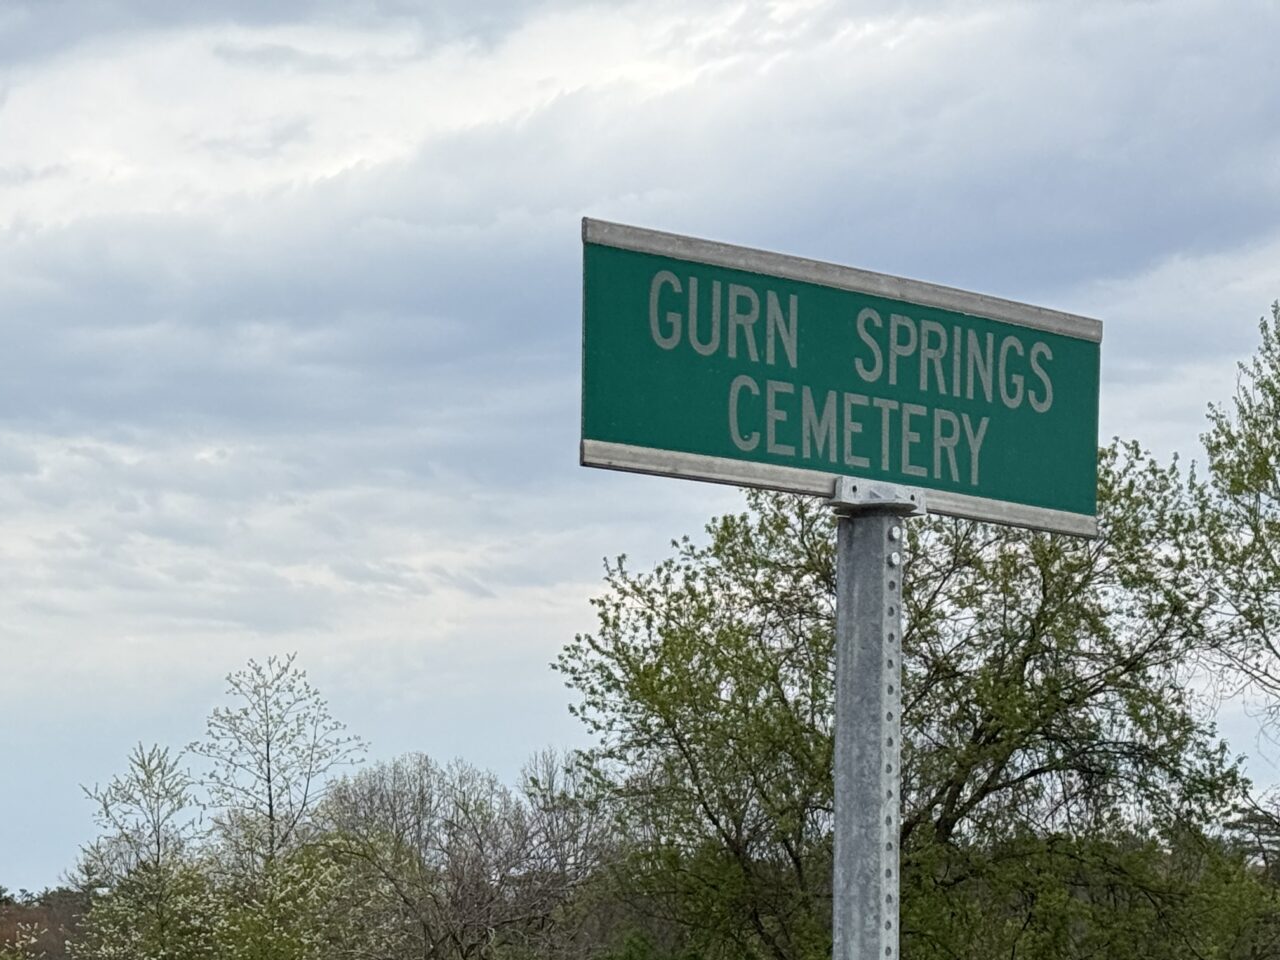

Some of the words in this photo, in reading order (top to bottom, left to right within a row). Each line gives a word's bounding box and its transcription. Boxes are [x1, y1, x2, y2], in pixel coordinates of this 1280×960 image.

[648, 269, 799, 369] GURN
[853, 306, 1054, 414] SPRINGS
[728, 374, 990, 486] CEMETERY
